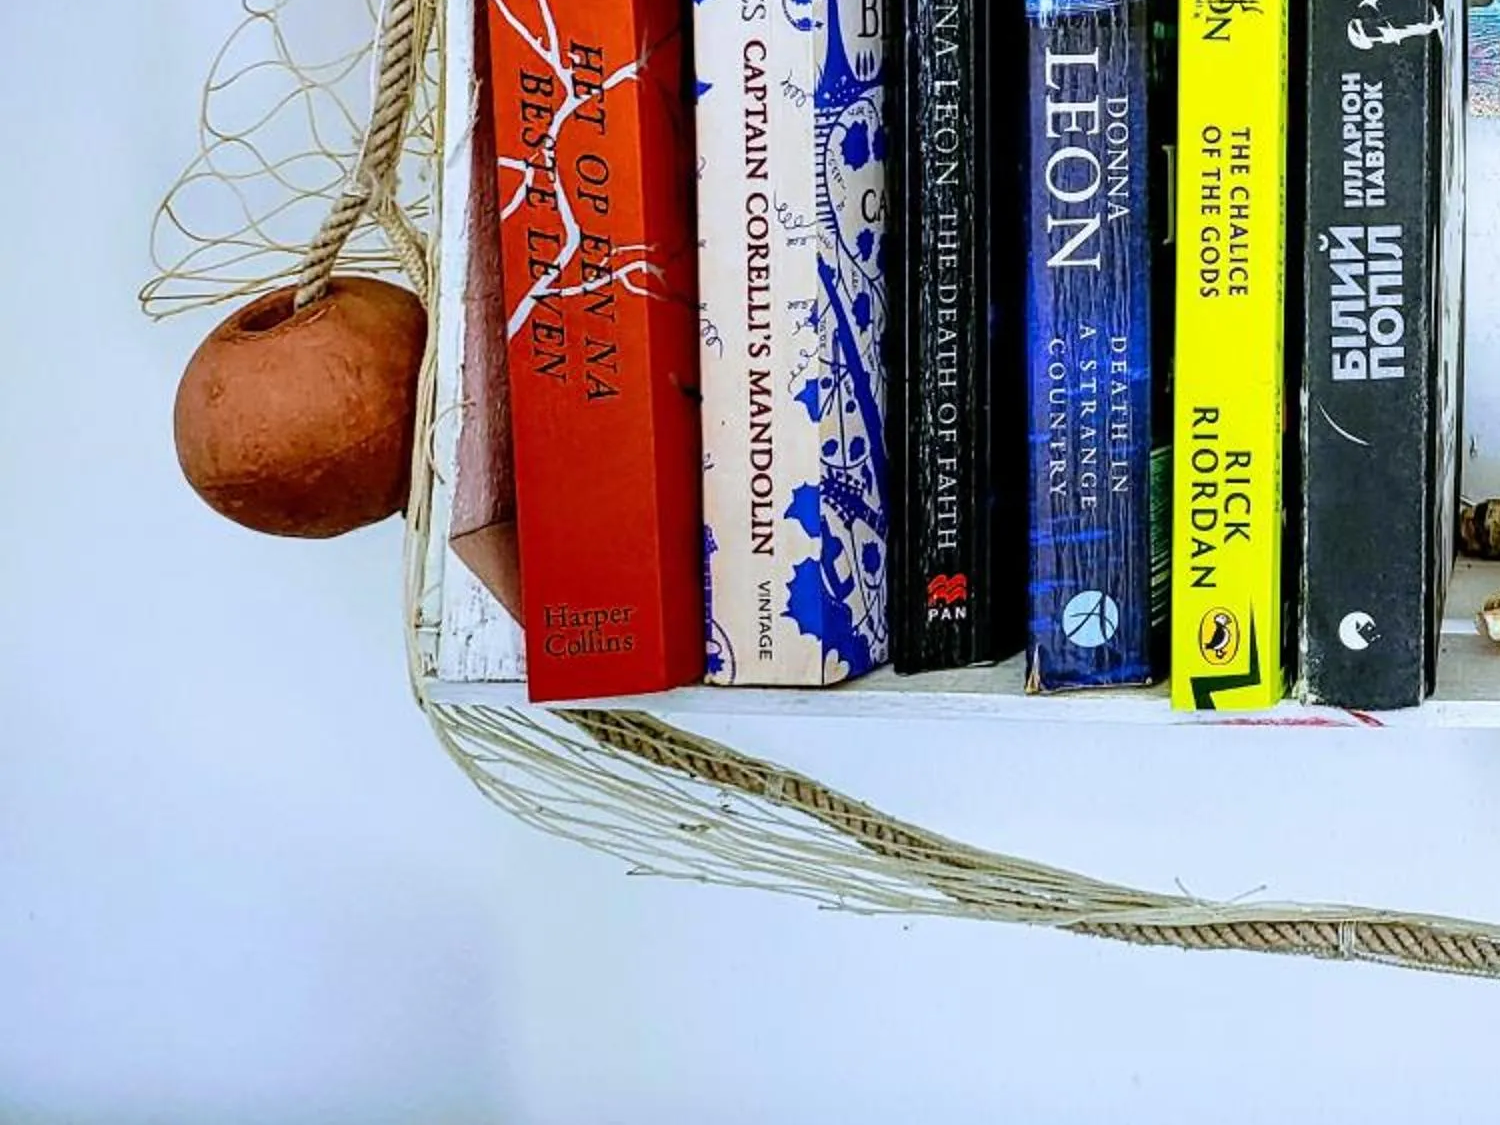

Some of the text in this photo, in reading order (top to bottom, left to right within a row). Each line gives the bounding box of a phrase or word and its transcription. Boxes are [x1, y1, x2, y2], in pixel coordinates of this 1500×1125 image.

[743, 39, 769, 180] CAPTAIN
[933, 79, 960, 187] LEON
[1045, 46, 1101, 272] LEON
[1107, 97, 1129, 221] DONNA
[1364, 80, 1386, 207] ПАВЛЮК
[520, 68, 568, 383] BESTE LEVEN
[570, 38, 620, 402] HET OP EEN NA
[745, 193, 772, 358] CORELLI'S
[936, 213, 960, 270] THE
[1199, 125, 1222, 299] OF THE GODS
[1228, 127, 1251, 297] THE CHALICE
[937, 284, 958, 390] DEATH
[1318, 225, 1367, 382] БІЛИЙ
[1367, 224, 1405, 380] ПОПІЛ
[748, 370, 774, 557] MANDOLIN
[937, 403, 957, 443] OF
[1047, 338, 1067, 497] COUNTRY
[1079, 323, 1098, 508] A STRANGE
[1110, 335, 1128, 493] DEATH IN
[937, 456, 958, 550] FAITH
[1190, 406, 1219, 589] RIORDAN
[1223, 451, 1252, 542] RICK
[543, 604, 636, 632] Harper
[544, 630, 635, 658] Collins
[757, 580, 773, 661] VINTAGE
[928, 607, 967, 621] PAN
